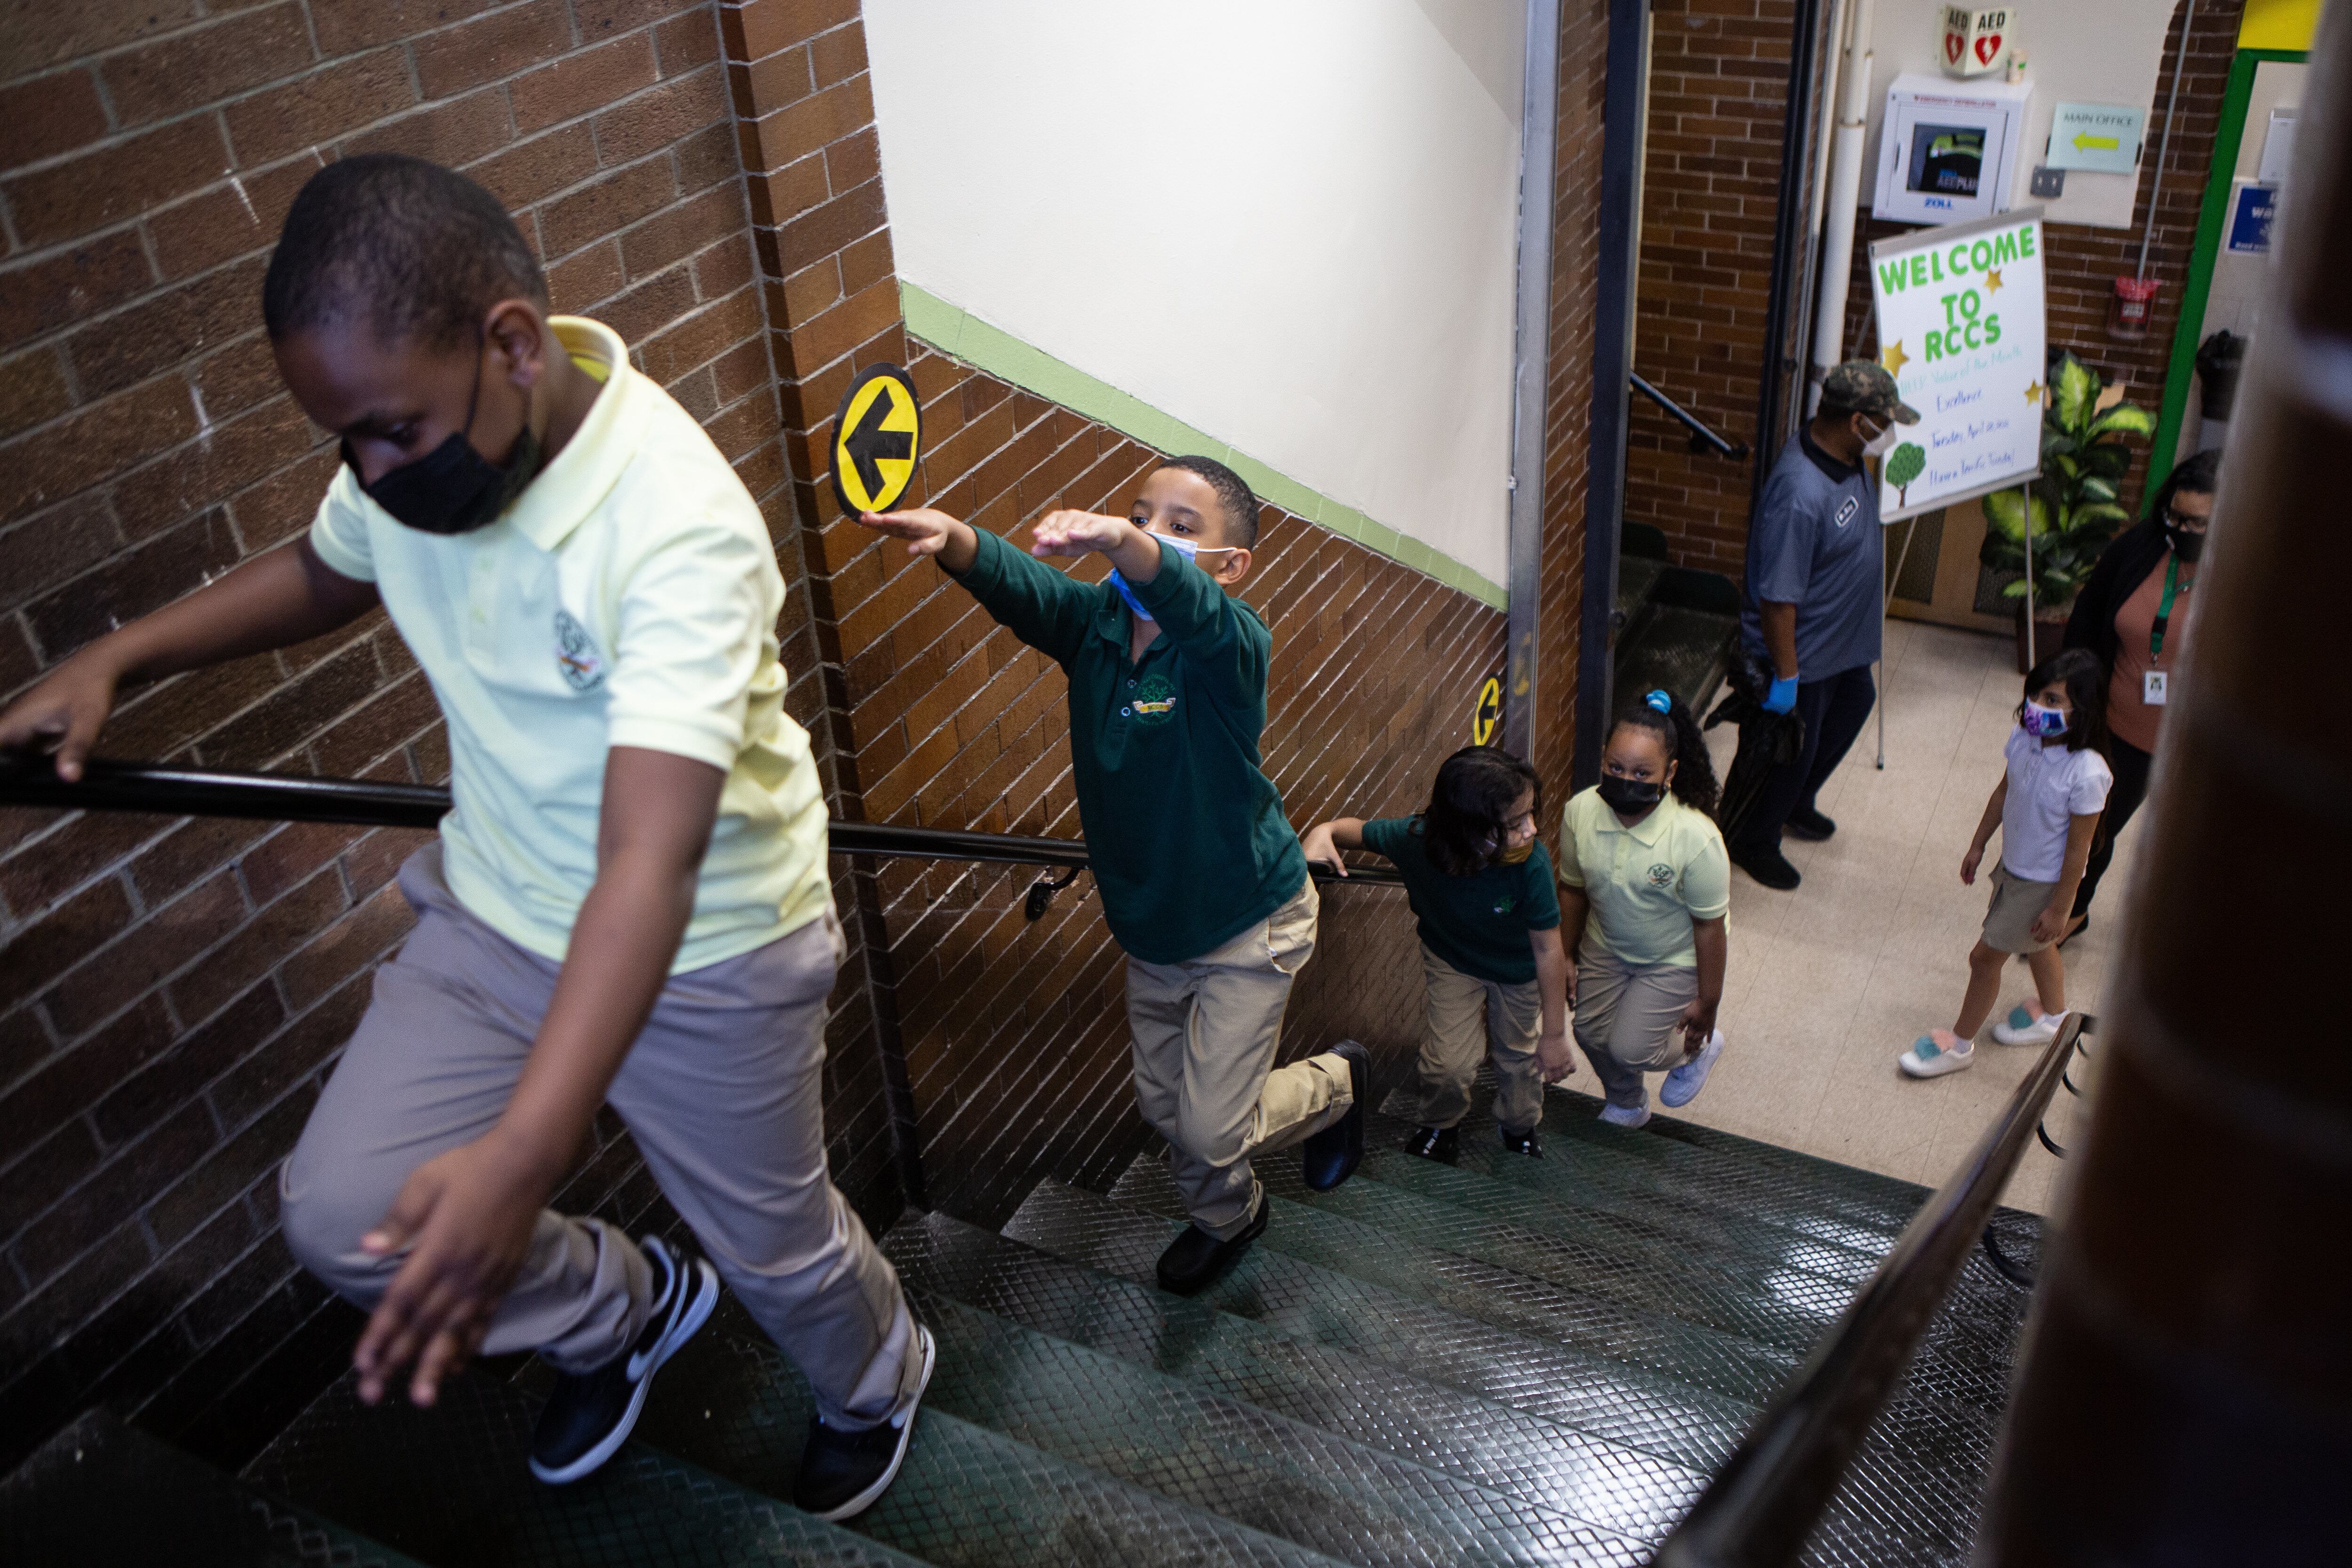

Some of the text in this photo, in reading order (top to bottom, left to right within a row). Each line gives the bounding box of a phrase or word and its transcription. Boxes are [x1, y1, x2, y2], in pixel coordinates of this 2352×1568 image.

[1949, 9, 1968, 31] AED
[1978, 11, 2006, 31] AED
[2064, 112, 2132, 127] MAIN OFFICE
[1879, 225, 2035, 296] WELCOME
[1941, 288, 1980, 326] TO
[1925, 313, 2001, 363] RCCS
